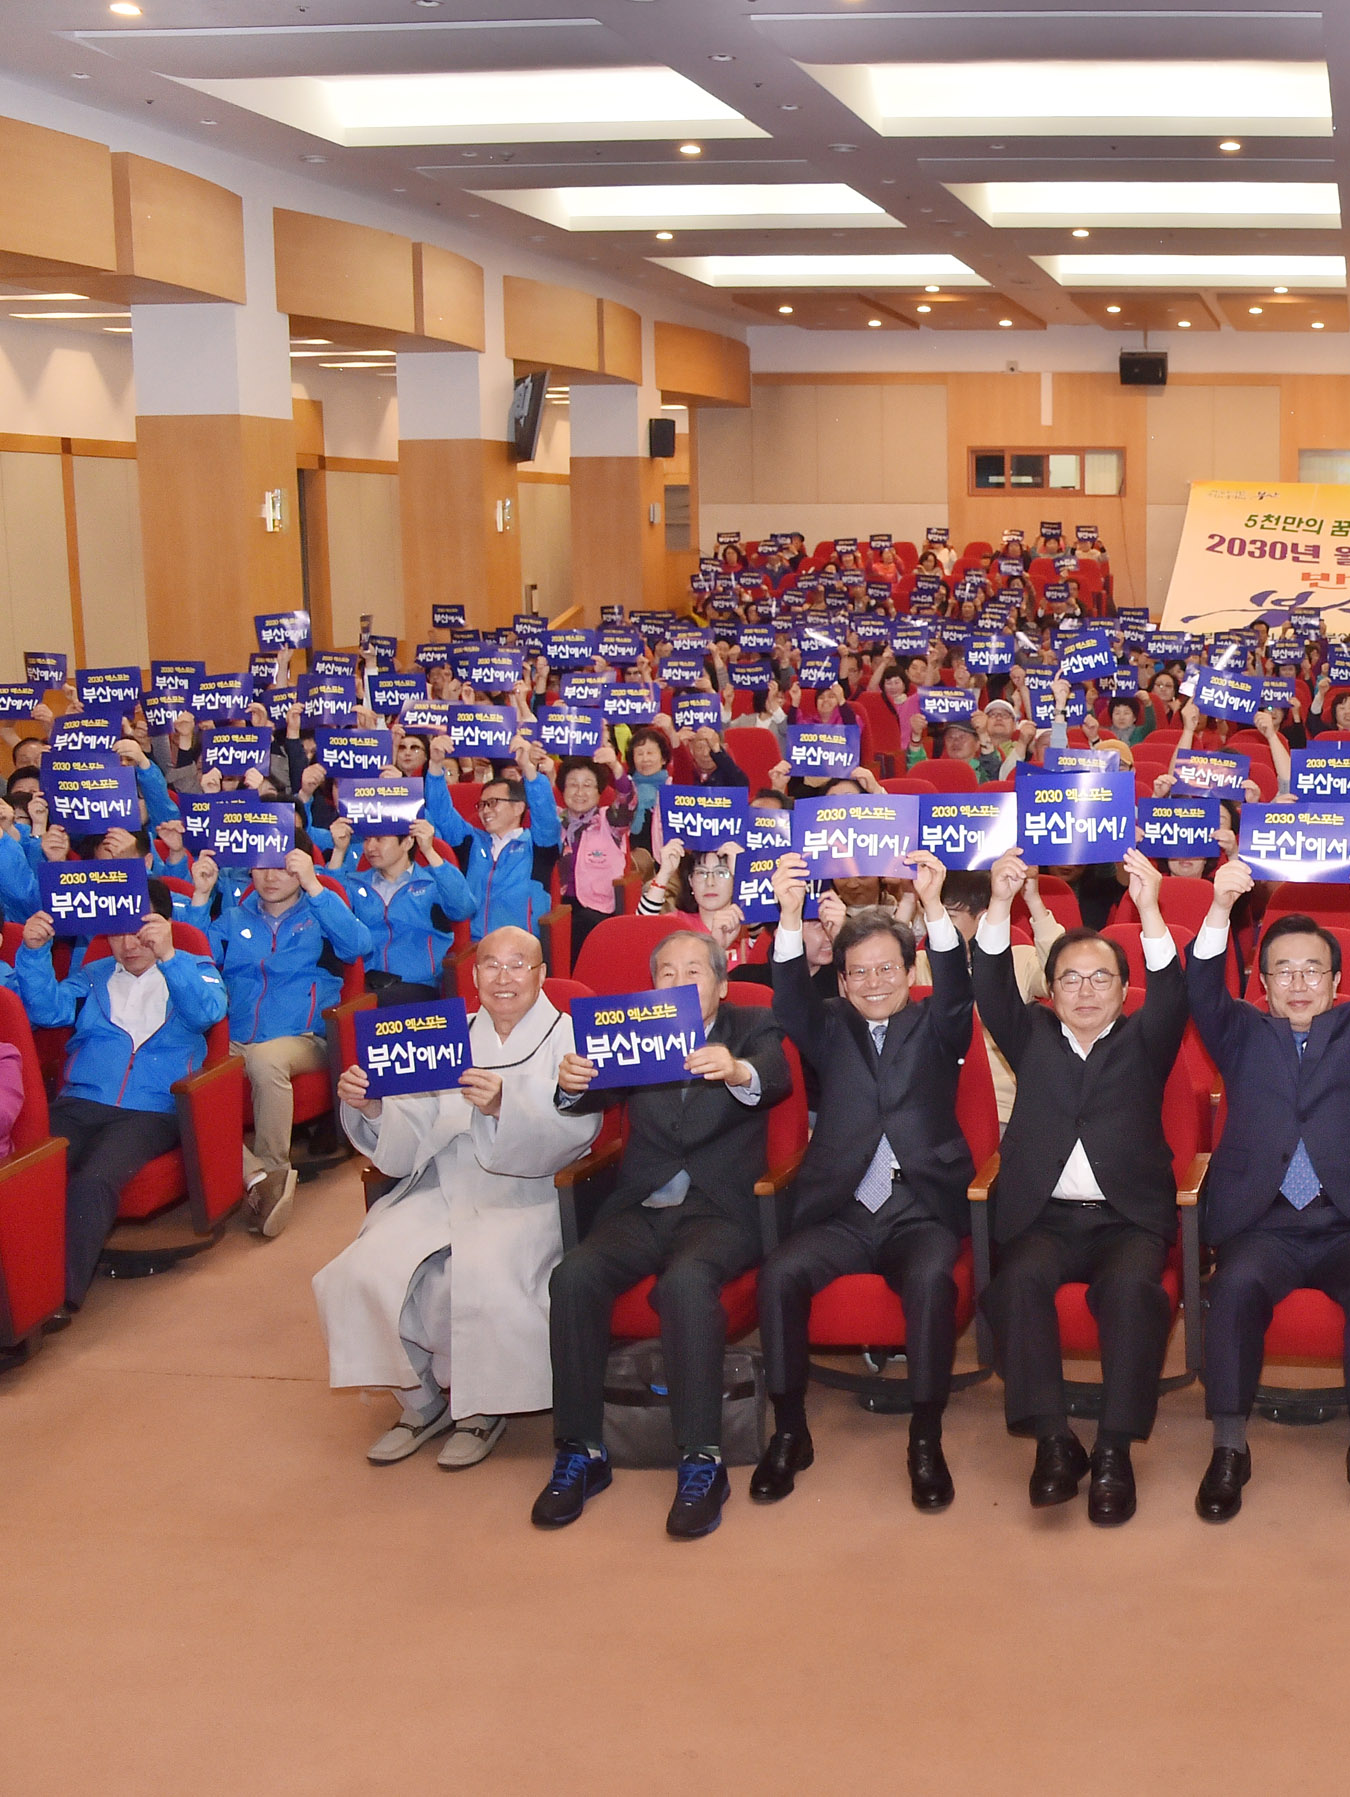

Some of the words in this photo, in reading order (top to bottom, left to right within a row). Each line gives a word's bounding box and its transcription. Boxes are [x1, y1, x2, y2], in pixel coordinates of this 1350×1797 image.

[1244, 514, 1324, 535] 5천만의
[1205, 533, 1321, 564] 2030년
[83, 686, 138, 703] 부산에서!
[192, 693, 248, 710] 부산에서!
[1200, 686, 1255, 712] 부산에서!
[604, 699, 656, 714] 부산에서!
[457, 713, 474, 721] 2030
[54, 732, 116, 750] 부산에서!
[330, 737, 348, 745] 2030
[451, 726, 512, 745] 부산에서!
[541, 725, 598, 745] 부산에서!
[206, 747, 265, 765] 부산에서!
[324, 749, 387, 769] 부산에서!
[791, 746, 853, 766] 부산에서!
[1307, 759, 1326, 768] 2030
[53, 762, 70, 770] 2030
[58, 781, 79, 790] 2030
[81, 779, 119, 790] 엑스포는
[1180, 766, 1242, 788] 부산에서!
[355, 788, 375, 796] 2030
[675, 796, 695, 806] 2030
[1035, 790, 1063, 803] 2030
[1065, 787, 1112, 804] 엑스포는
[54, 796, 131, 819] 부산에서!
[817, 808, 846, 821] 2030
[849, 807, 896, 820] 엑스포는
[932, 806, 958, 817] 2030
[960, 805, 1000, 820] 엑스포는
[1153, 808, 1172, 817] 2030
[224, 814, 242, 823] 2030
[668, 811, 741, 836] 부산에서!
[1025, 810, 1127, 845] 부산에서!
[1265, 814, 1295, 824] 2030
[1298, 813, 1344, 825] 엑스포는
[215, 829, 288, 852] 부산에서!
[1144, 822, 1214, 844] 부산에서!
[803, 828, 908, 859] 부산에서!
[60, 873, 86, 884] 2030
[89, 871, 127, 883] 엑스포는
[52, 891, 141, 918] 부산에서!
[595, 1010, 625, 1025] 2030
[627, 1002, 677, 1022] 엑스포는
[376, 1021, 403, 1035] 2030
[405, 1015, 447, 1031] 엑스포는
[587, 1031, 695, 1067] 부산에서!
[368, 1041, 462, 1076] 부산에서!
